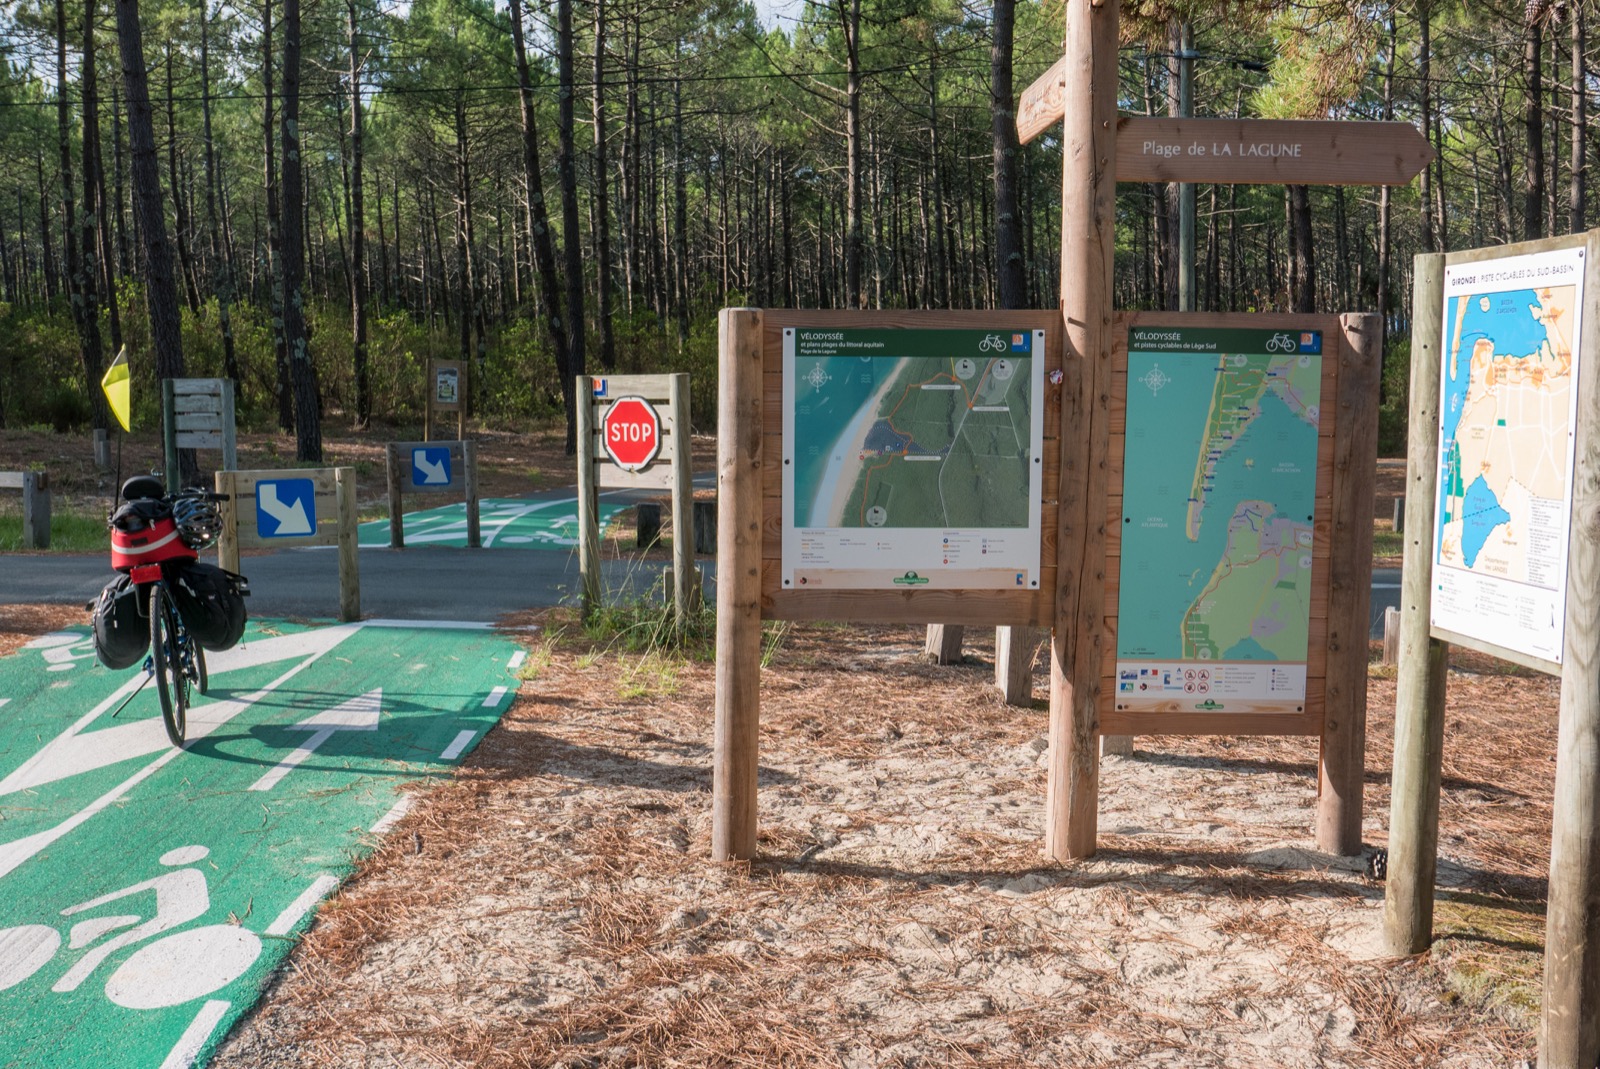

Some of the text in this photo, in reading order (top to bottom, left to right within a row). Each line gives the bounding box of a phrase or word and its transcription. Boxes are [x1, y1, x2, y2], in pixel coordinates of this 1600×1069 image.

[1143, 141, 1302, 159] Plage de LA LAGUNE
[1452, 276, 1476, 286] GIRONDE
[1481, 273, 1494, 283] PISTE
[1496, 269, 1525, 281] CYCLABLES
[1527, 268, 1535, 278] DU
[1537, 264, 1574, 276] SUD-BASSIN
[800, 332, 844, 340] VÉLODYSSÉE
[1134, 331, 1181, 341] VÉLODYSSÉE
[1192, 342, 1205, 350] Lège
[611, 422, 652, 442] STOP
